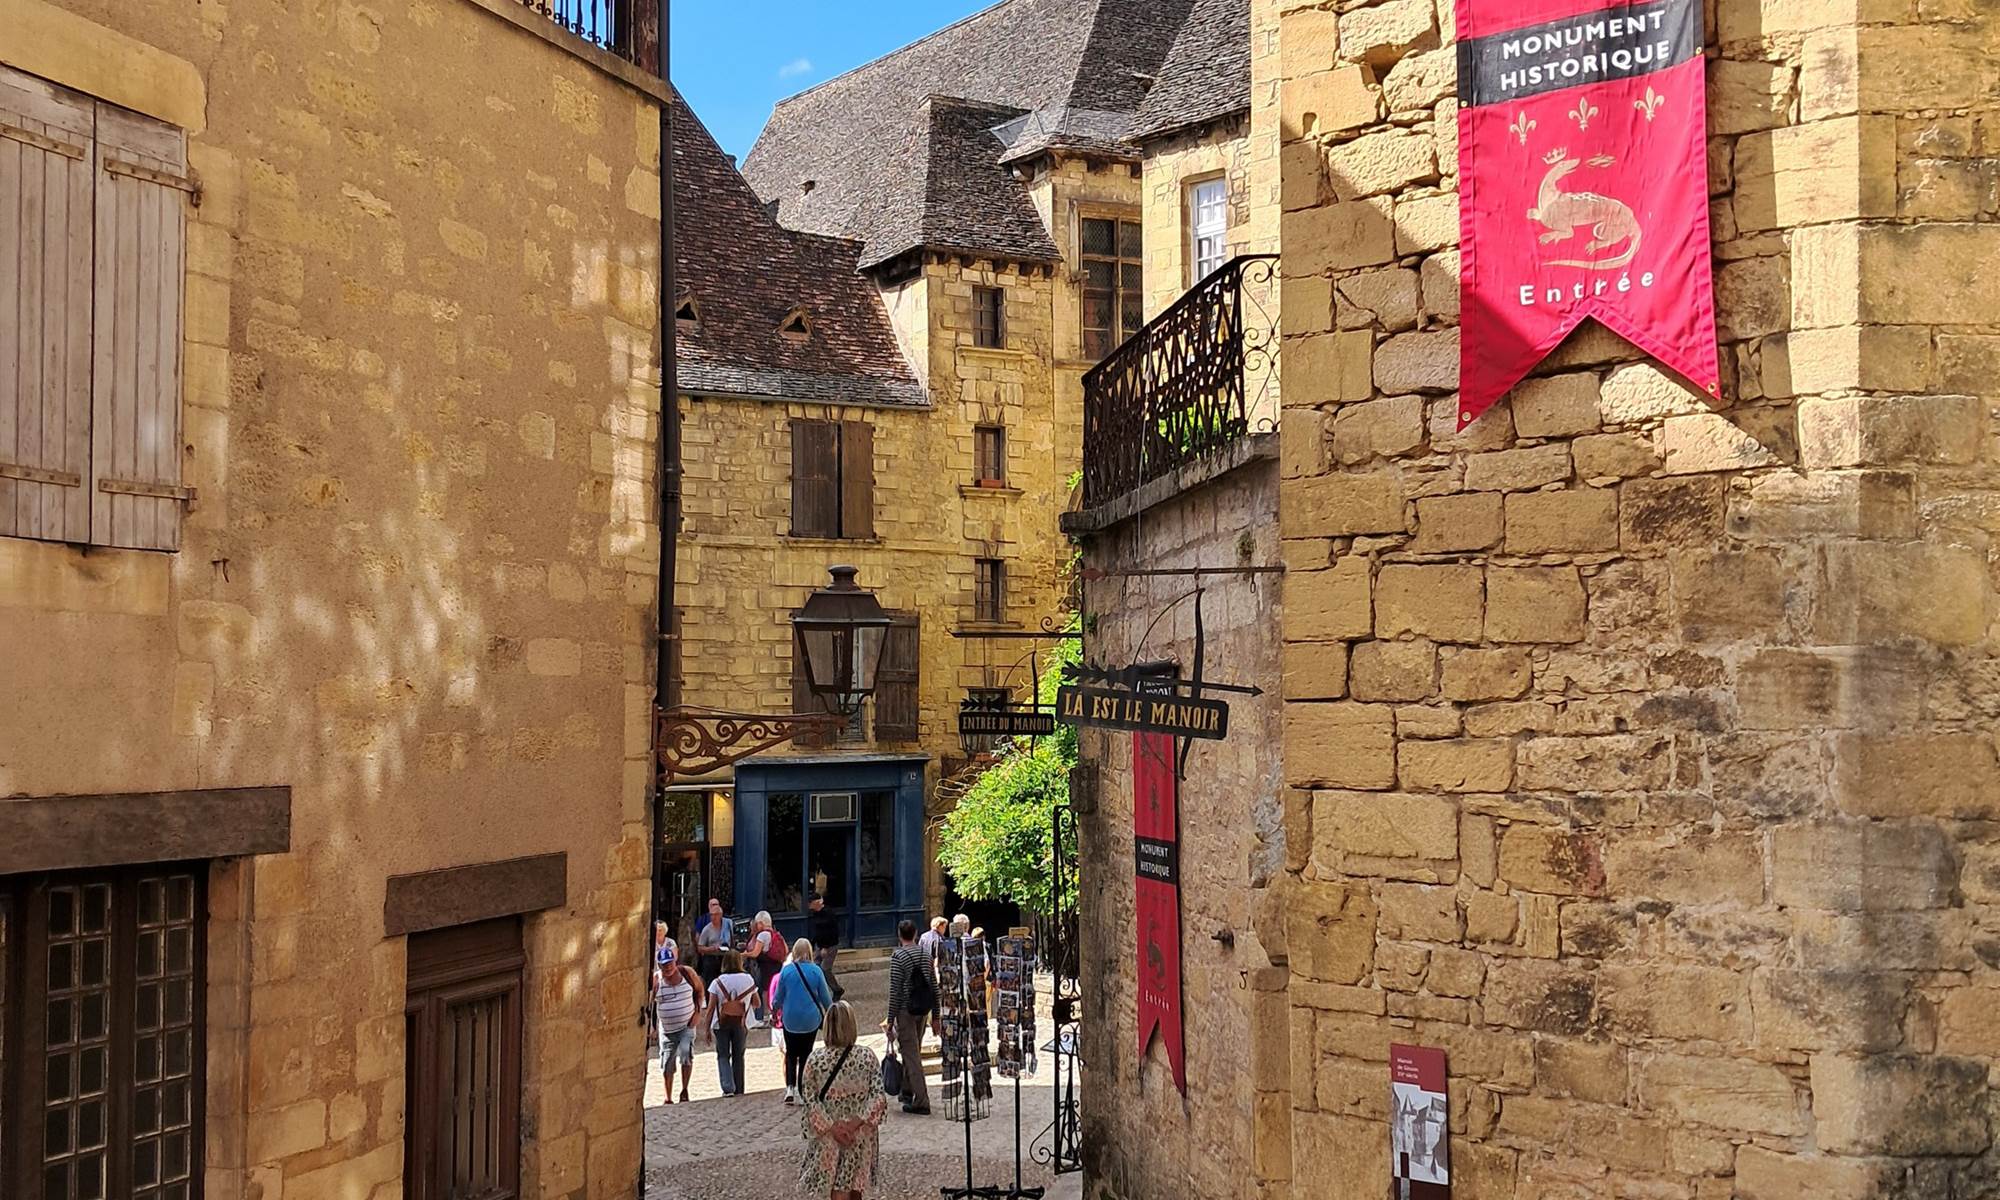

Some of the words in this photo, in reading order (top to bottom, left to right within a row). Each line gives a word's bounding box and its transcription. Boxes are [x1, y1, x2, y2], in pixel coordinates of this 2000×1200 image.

[1502, 10, 1666, 60] MONUMENT
[1500, 40, 1670, 92] HISTORIQUE
[1519, 270, 1655, 306] Entrée
[999, 717, 1010, 730] DU
[1013, 717, 1052, 731] MANOIR
[1092, 695, 1119, 720] EST
[1124, 699, 1142, 722] LE
[1150, 702, 1219, 730] MANOIR
[1140, 843, 1168, 858] MONUMENT
[1140, 860, 1170, 877] HISTORIQUE
